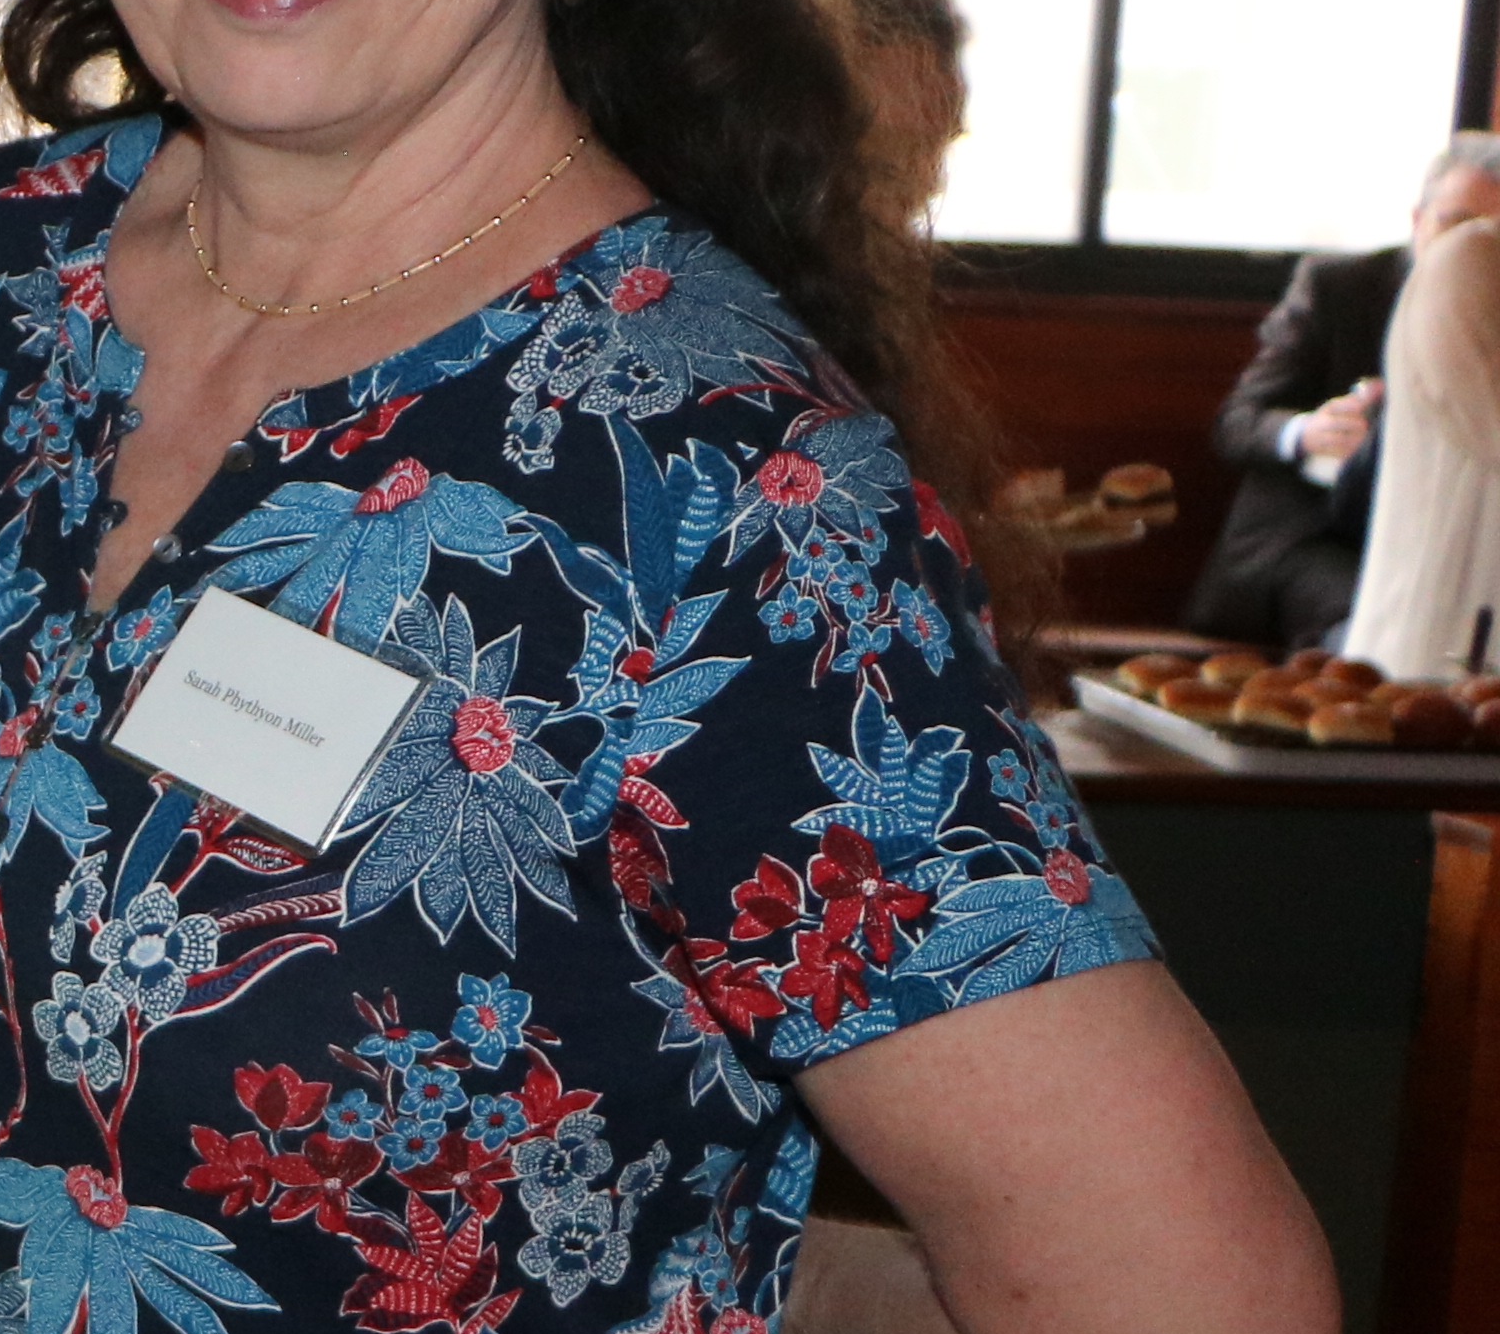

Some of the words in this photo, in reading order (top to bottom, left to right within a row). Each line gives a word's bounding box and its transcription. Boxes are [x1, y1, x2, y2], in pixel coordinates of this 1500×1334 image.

[183, 668, 221, 698] Sarah
[221, 686, 284, 729] Phythyon
[283, 717, 326, 748] Miller
